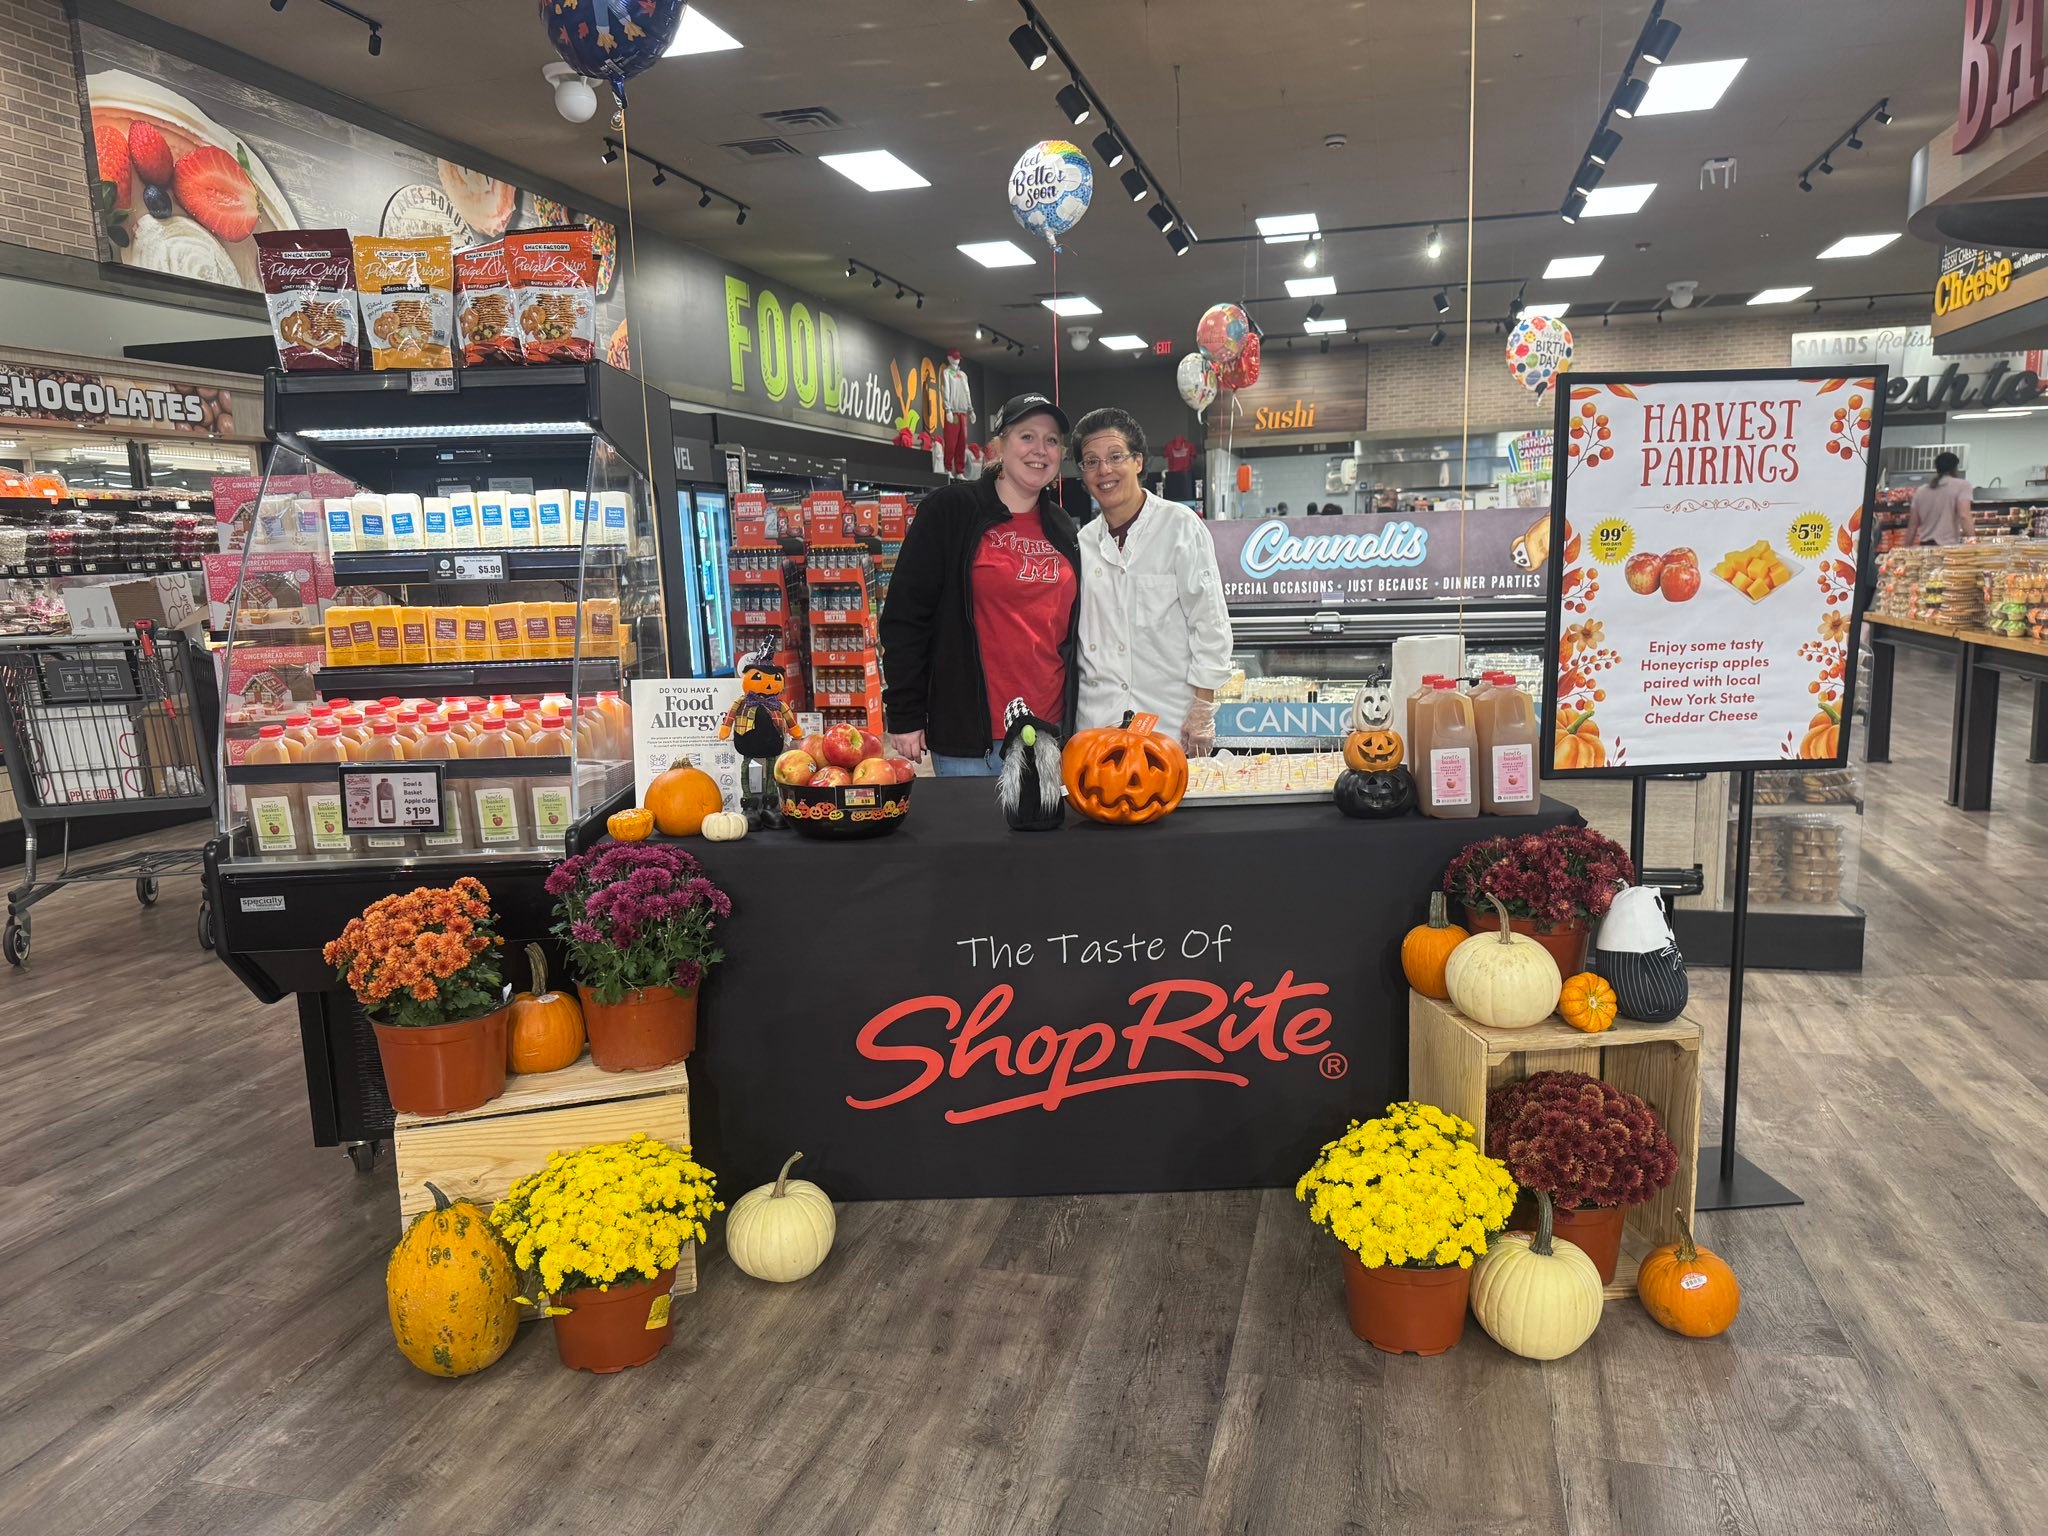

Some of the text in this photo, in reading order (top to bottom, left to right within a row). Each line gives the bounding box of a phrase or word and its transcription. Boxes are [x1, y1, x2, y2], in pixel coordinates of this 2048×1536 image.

[1952, 0, 2048, 156] BA
[430, 188, 474, 245] DONUTS
[270, 262, 309, 281] Pretzel
[1934, 258, 2013, 316] Cheese
[725, 275, 843, 413] FOOD
[838, 377, 864, 418] on
[865, 372, 893, 425] the
[1156, 341, 1172, 354] EXIT
[1535, 340, 1565, 357] BIRTH
[1796, 335, 1868, 356] SALADS
[1878, 330, 1933, 355] Rotiss
[1538, 353, 1560, 370] DAY
[434, 377, 453, 387] 4.99
[1885, 362, 1972, 411] esh
[1254, 400, 1316, 430] Sushi
[1642, 399, 1802, 443] HARVEST
[673, 446, 695, 471] VEL
[1518, 447, 1554, 459] CANDLES
[1640, 443, 1799, 487] PAIRINGS
[844, 515, 853, 524] G
[863, 509, 872, 519] G
[985, 530, 1060, 556] MARIS
[1243, 521, 1425, 574] Cannolis
[227, 559, 269, 567] GINGBREAD
[478, 565, 501, 574] $5.99
[1016, 555, 1059, 583] M
[1224, 574, 1541, 596] SPECIAL OCCASIONS JUST BECAUSE DINNER PARTIES
[1649, 638, 1764, 656] Enjoy some tasty
[1640, 656, 1770, 674] Honeycrisp apples
[1643, 673, 1761, 692] paired with local
[665, 694, 715, 712] Food
[1650, 692, 1756, 707] New York State
[1235, 706, 1356, 734] CANNO
[1644, 710, 1758, 724] Cheddar Cheese
[957, 924, 1233, 969] The Taste Of
[846, 970, 1333, 1124] ShopRite
